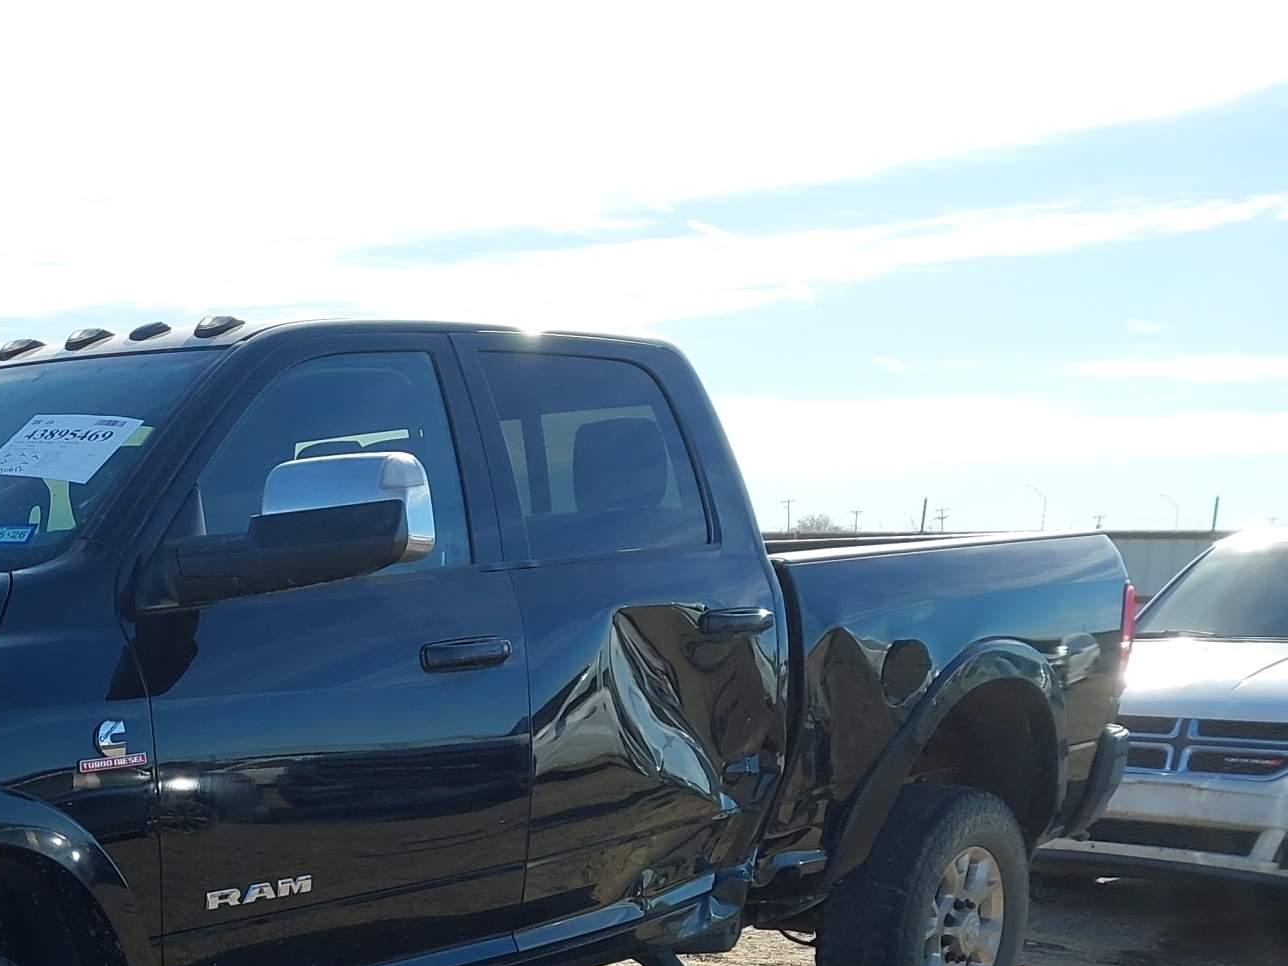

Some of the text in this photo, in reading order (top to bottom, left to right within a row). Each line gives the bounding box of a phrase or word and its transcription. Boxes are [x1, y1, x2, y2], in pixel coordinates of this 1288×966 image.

[24, 428, 114, 442] 43895469
[83, 755, 144, 769] TURBO DIESEL
[205, 874, 313, 911] RAM
